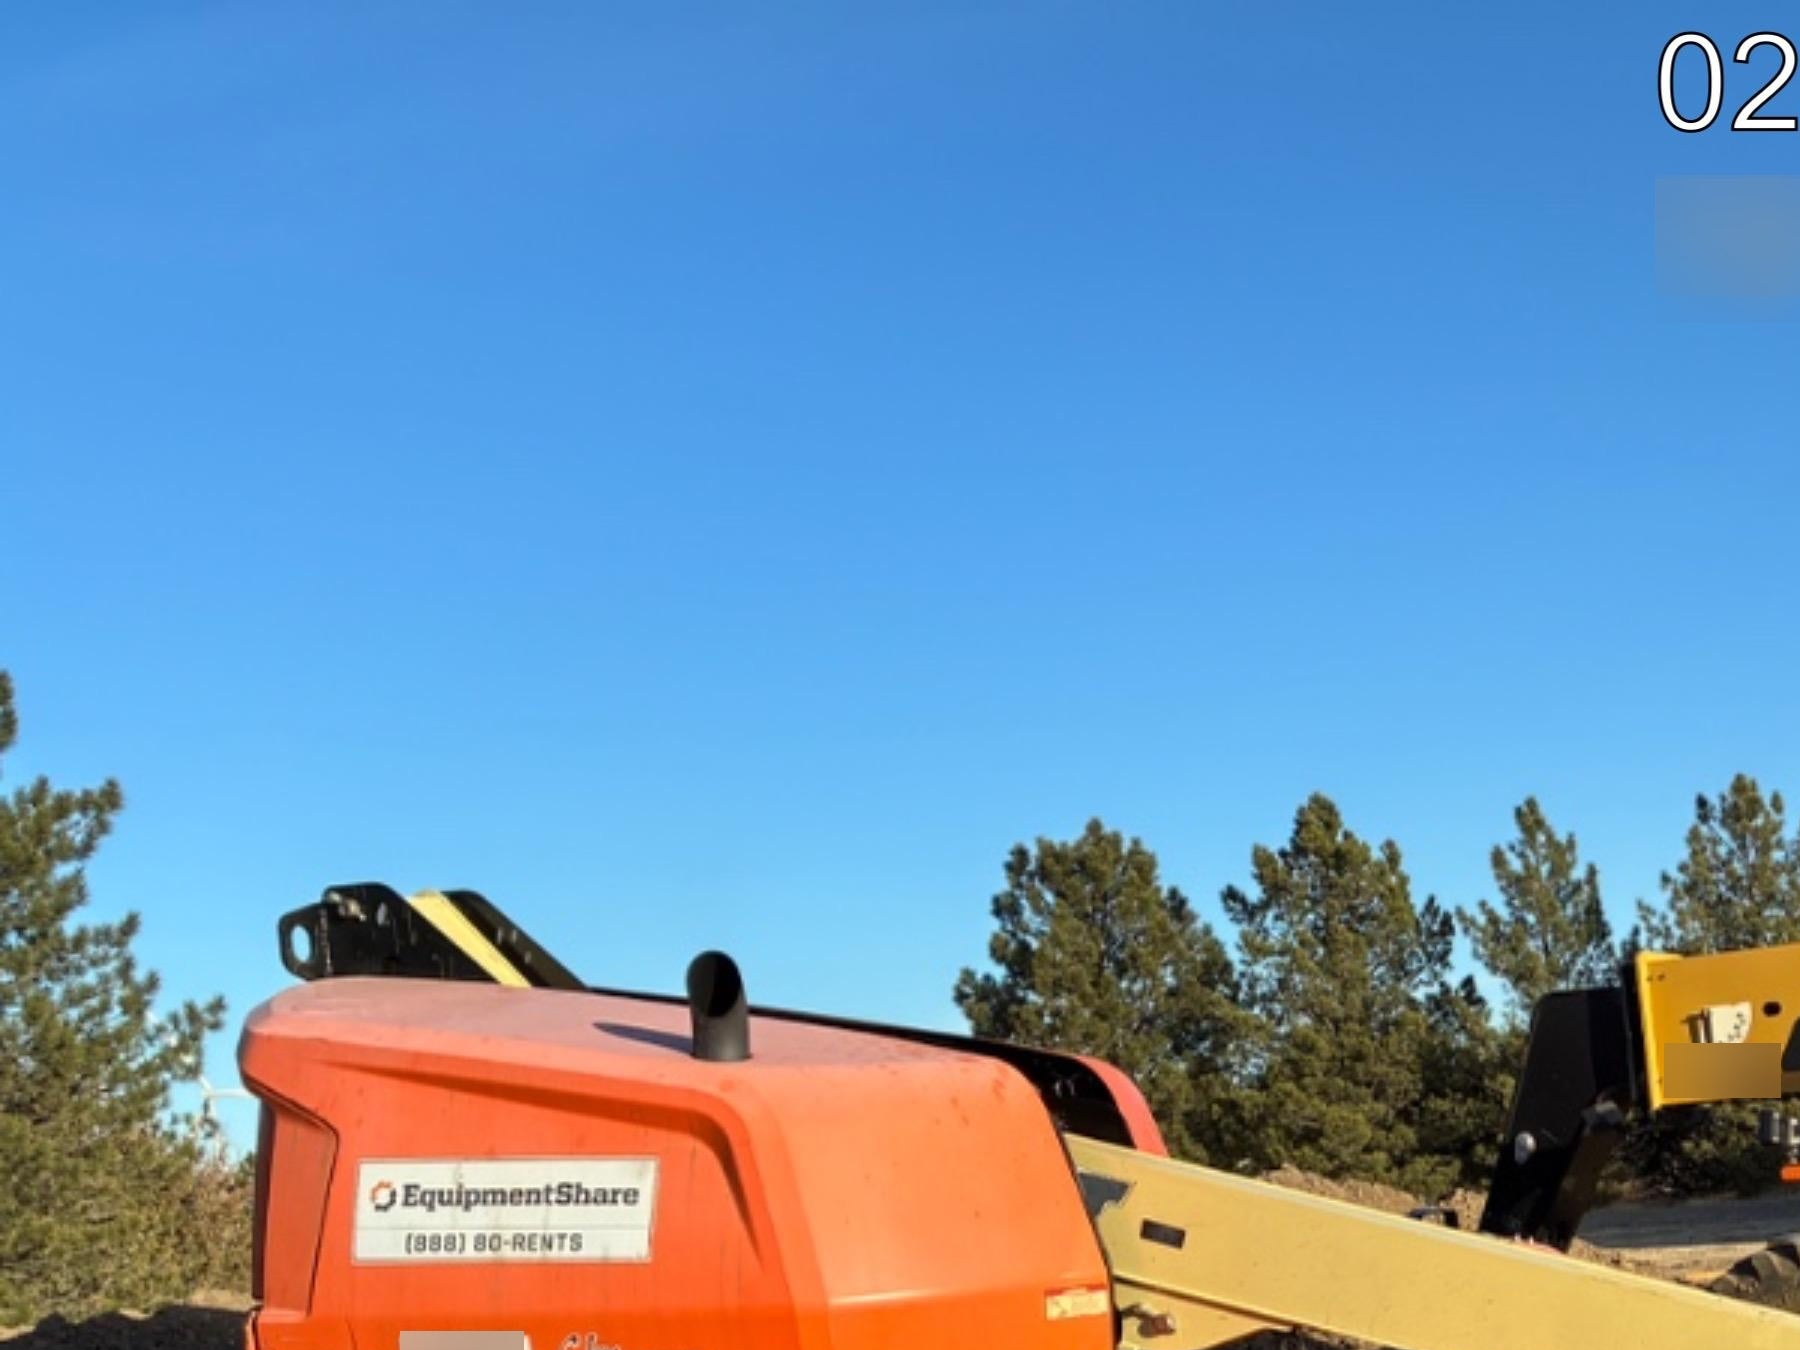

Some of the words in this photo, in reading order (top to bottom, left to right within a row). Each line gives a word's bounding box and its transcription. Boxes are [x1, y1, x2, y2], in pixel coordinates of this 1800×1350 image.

[401, 1182, 640, 1212] EquipmentShare
[405, 1233, 466, 1254] (888)
[473, 1232, 583, 1252] 80-RENTS
